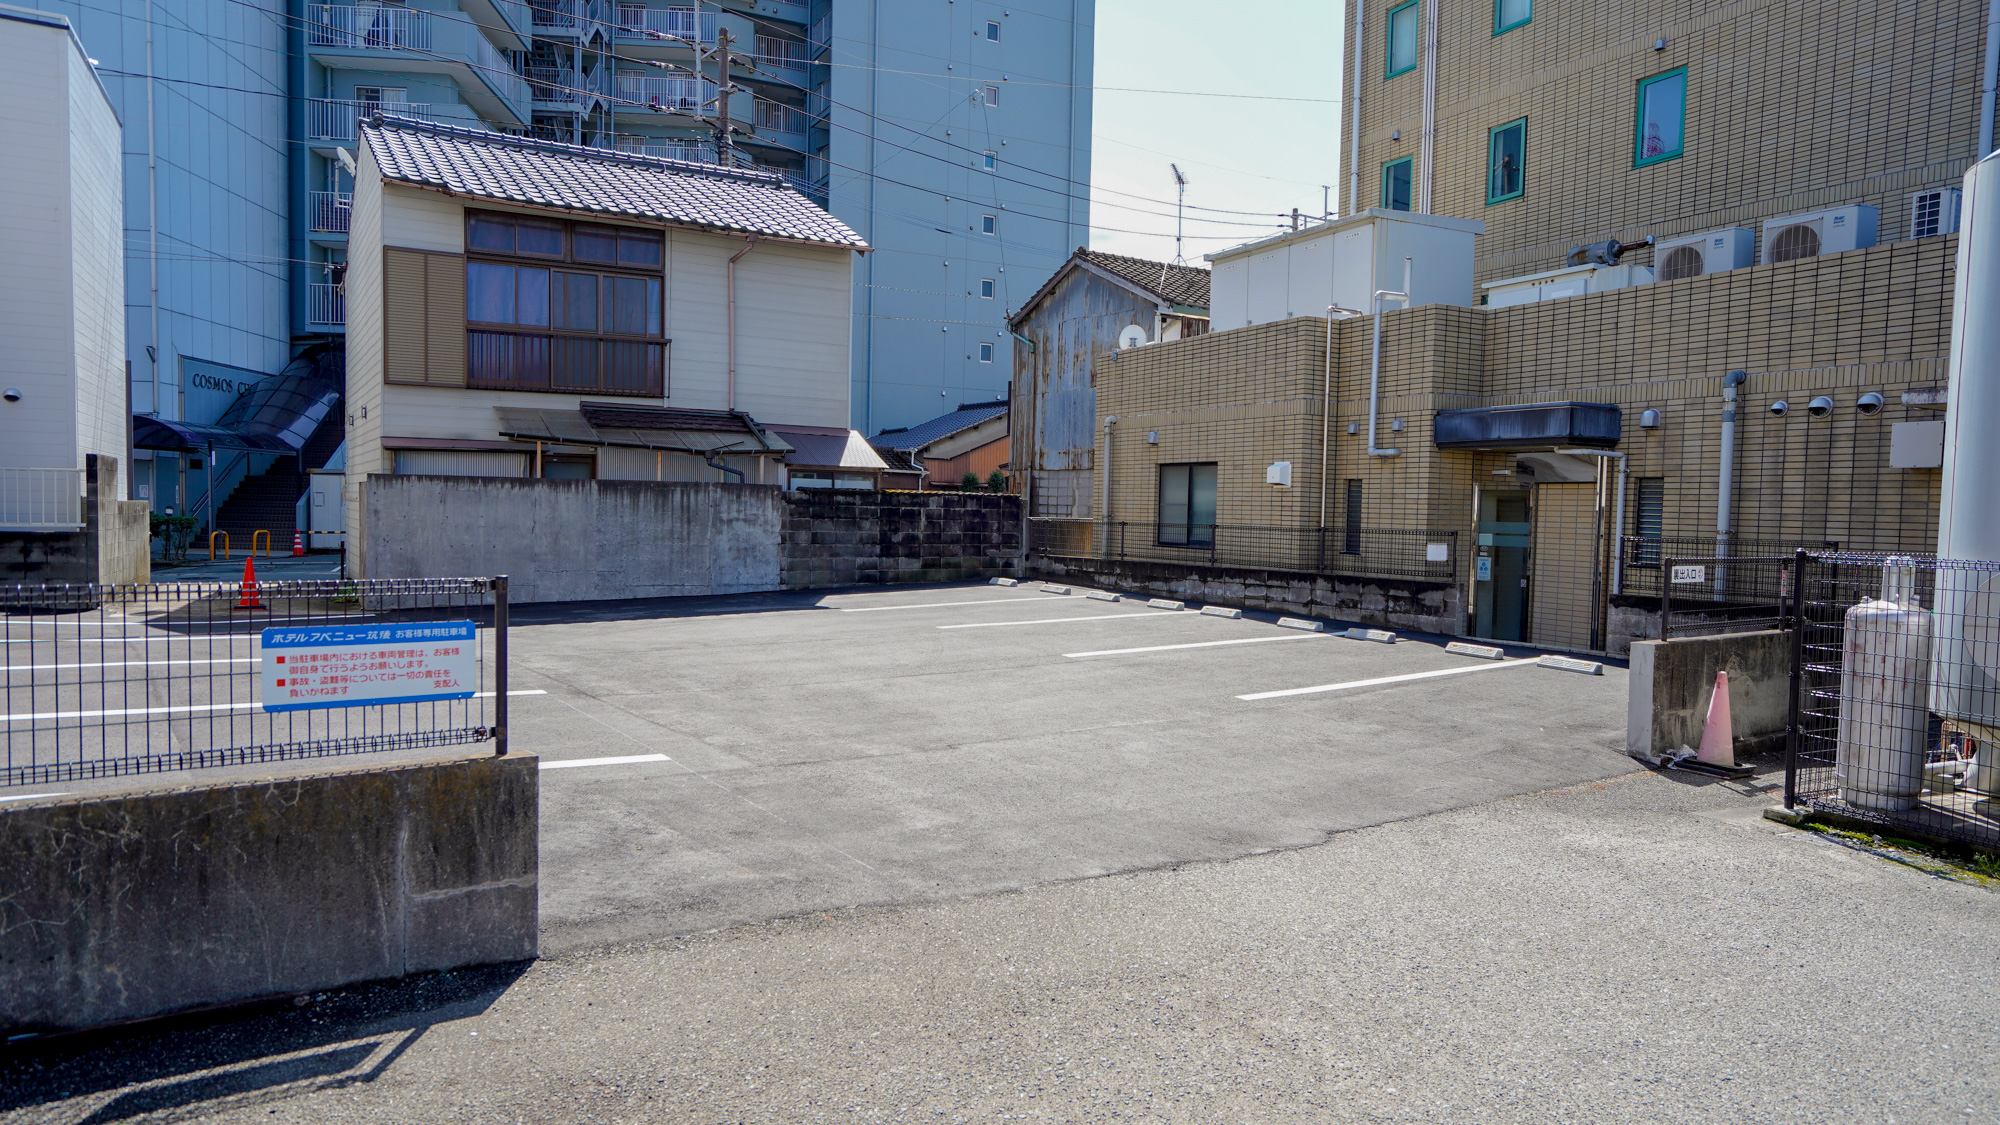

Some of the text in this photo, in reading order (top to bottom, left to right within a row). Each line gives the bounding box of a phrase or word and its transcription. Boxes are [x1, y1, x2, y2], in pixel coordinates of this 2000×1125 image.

[192, 373, 233, 393] COSMOS
[395, 626, 468, 639] お客様専用駐車場
[433, 678, 460, 688] 支配人
[289, 686, 349, 698] 負いかねます
